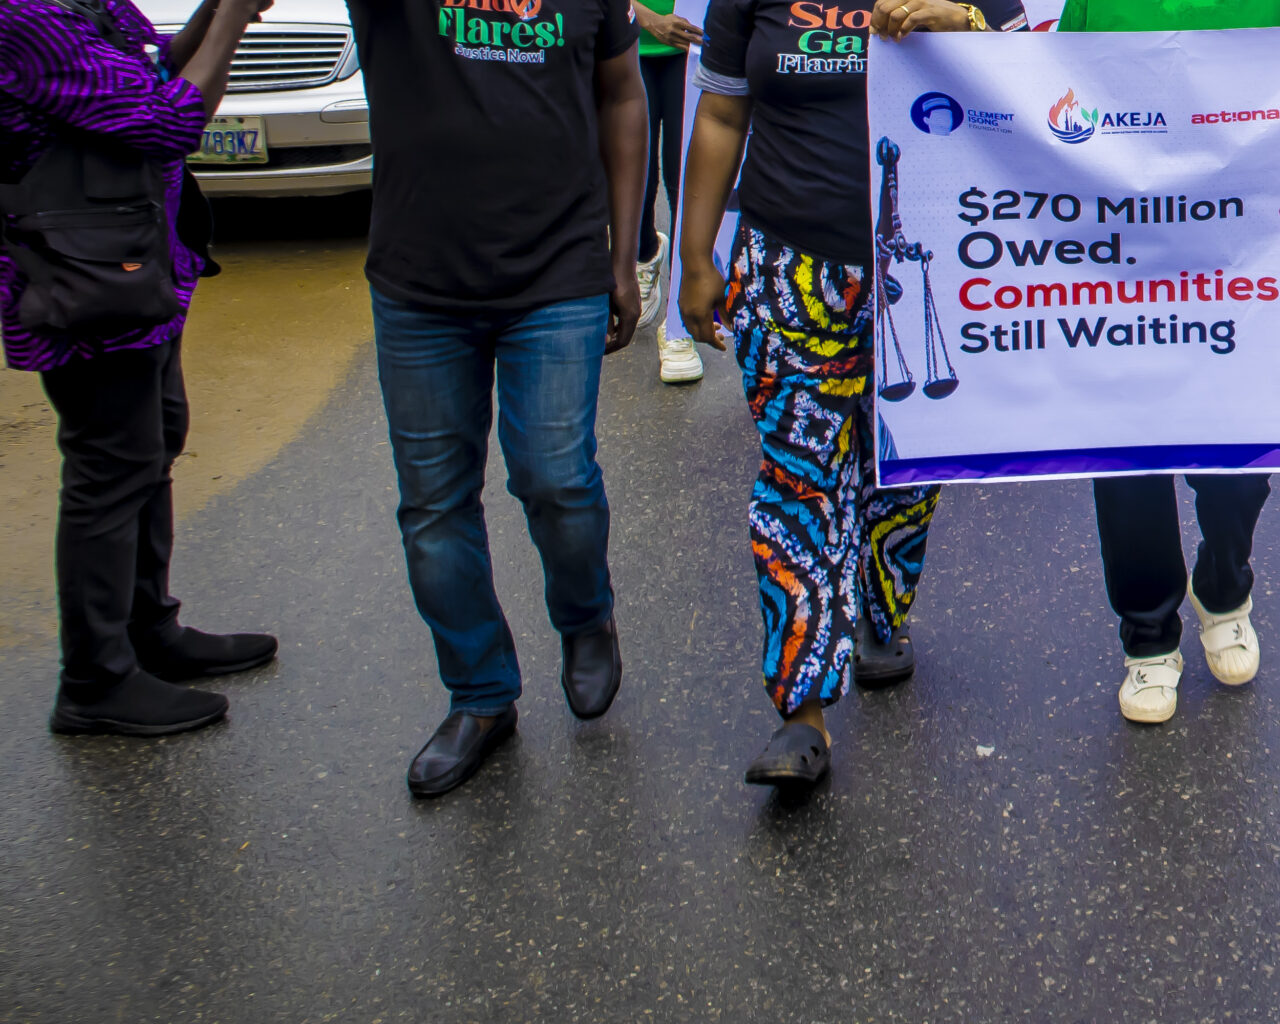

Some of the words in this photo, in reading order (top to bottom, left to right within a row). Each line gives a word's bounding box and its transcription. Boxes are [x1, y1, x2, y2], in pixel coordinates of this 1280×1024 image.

[438, 6, 565, 48] Flares!
[788, 1, 872, 29] Sto
[454, 43, 506, 62] Justice
[507, 48, 545, 63] Now!
[798, 29, 865, 54] Ga
[967, 109, 1014, 121] CLEMENT
[968, 116, 999, 126] ISONG
[1101, 112, 1167, 127] AKEJA
[957, 186, 1081, 226] $270
[1096, 194, 1244, 224] Million
[957, 231, 1137, 269] Owed.
[958, 269, 1280, 311] Communities
[960, 319, 1046, 354] Still
[1057, 314, 1236, 355] Waiting
